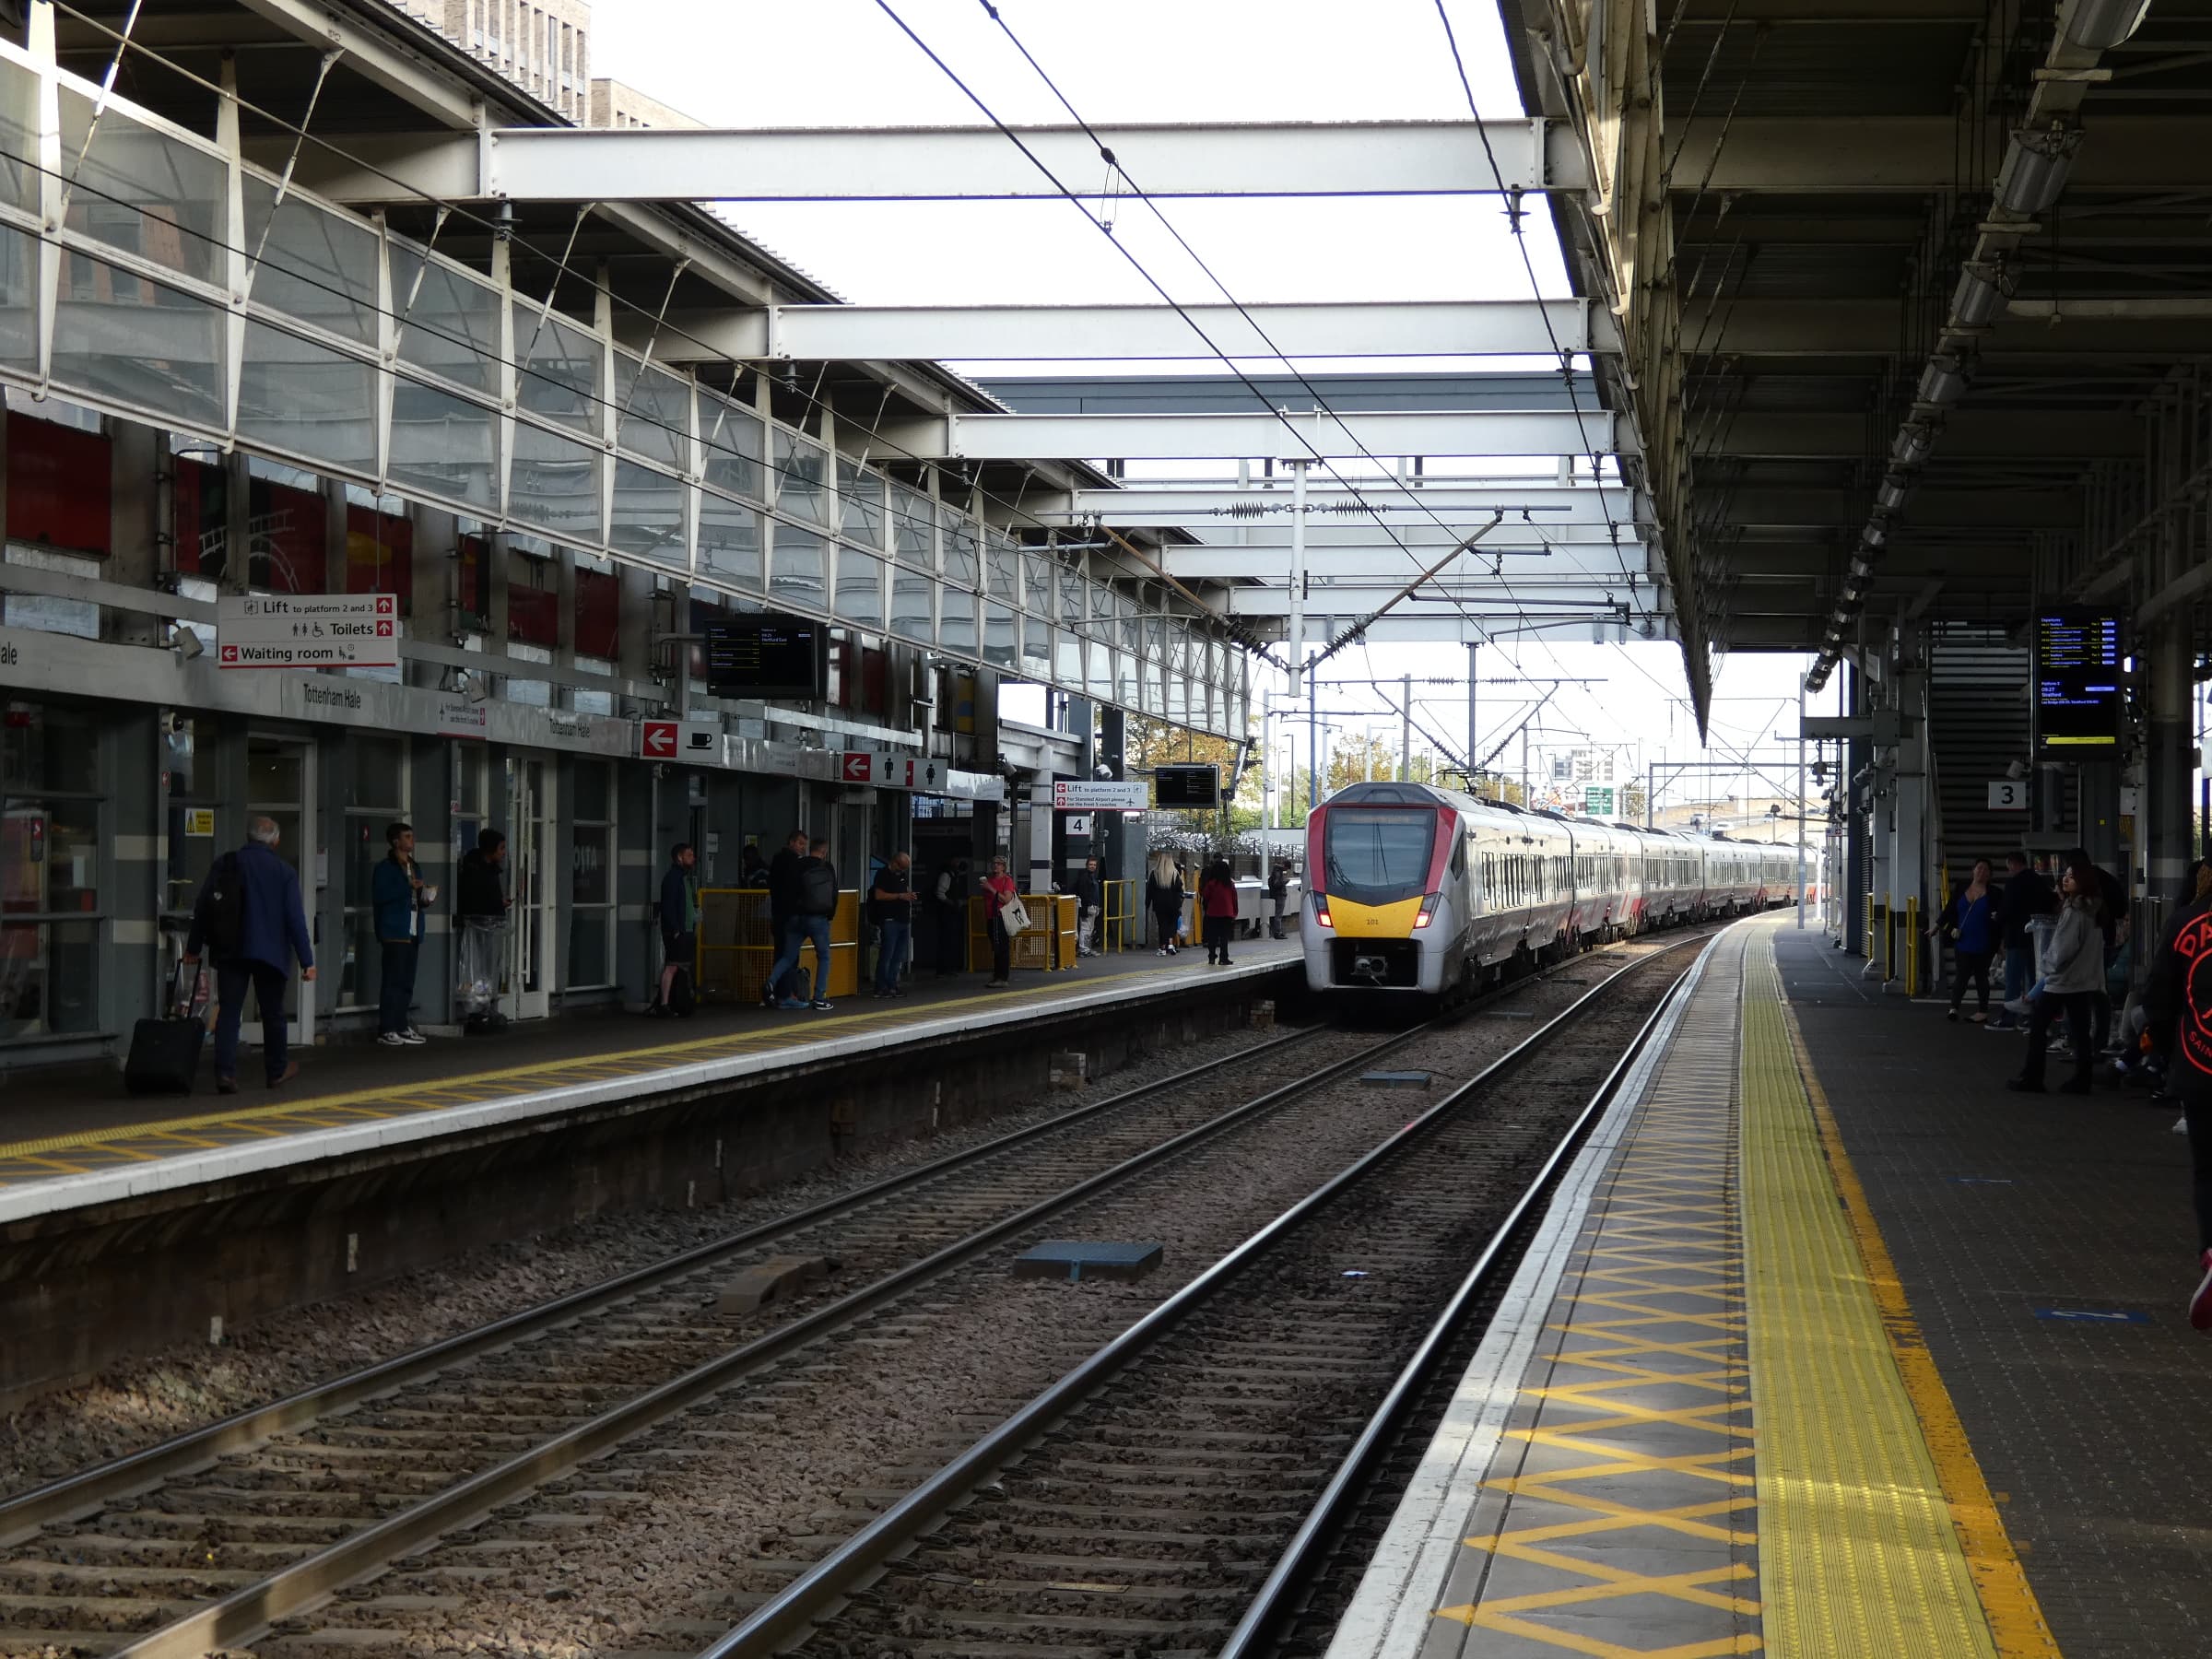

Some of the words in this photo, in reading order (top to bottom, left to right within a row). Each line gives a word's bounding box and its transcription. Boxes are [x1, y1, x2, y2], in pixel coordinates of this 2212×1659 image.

[264, 601, 288, 614] Lift
[304, 604, 340, 615] platform
[350, 604, 365, 612] and
[330, 623, 373, 635] Toilets
[241, 647, 292, 662] Waiting
[297, 649, 333, 659] room
[303, 683, 343, 707] Tottenham
[344, 689, 361, 709] Hale
[549, 718, 577, 736] Tottenham
[578, 723, 591, 738] Hale
[1067, 784, 1082, 793] Lift
[2001, 785, 2014, 805] 3
[1073, 818, 1084, 831] 4
